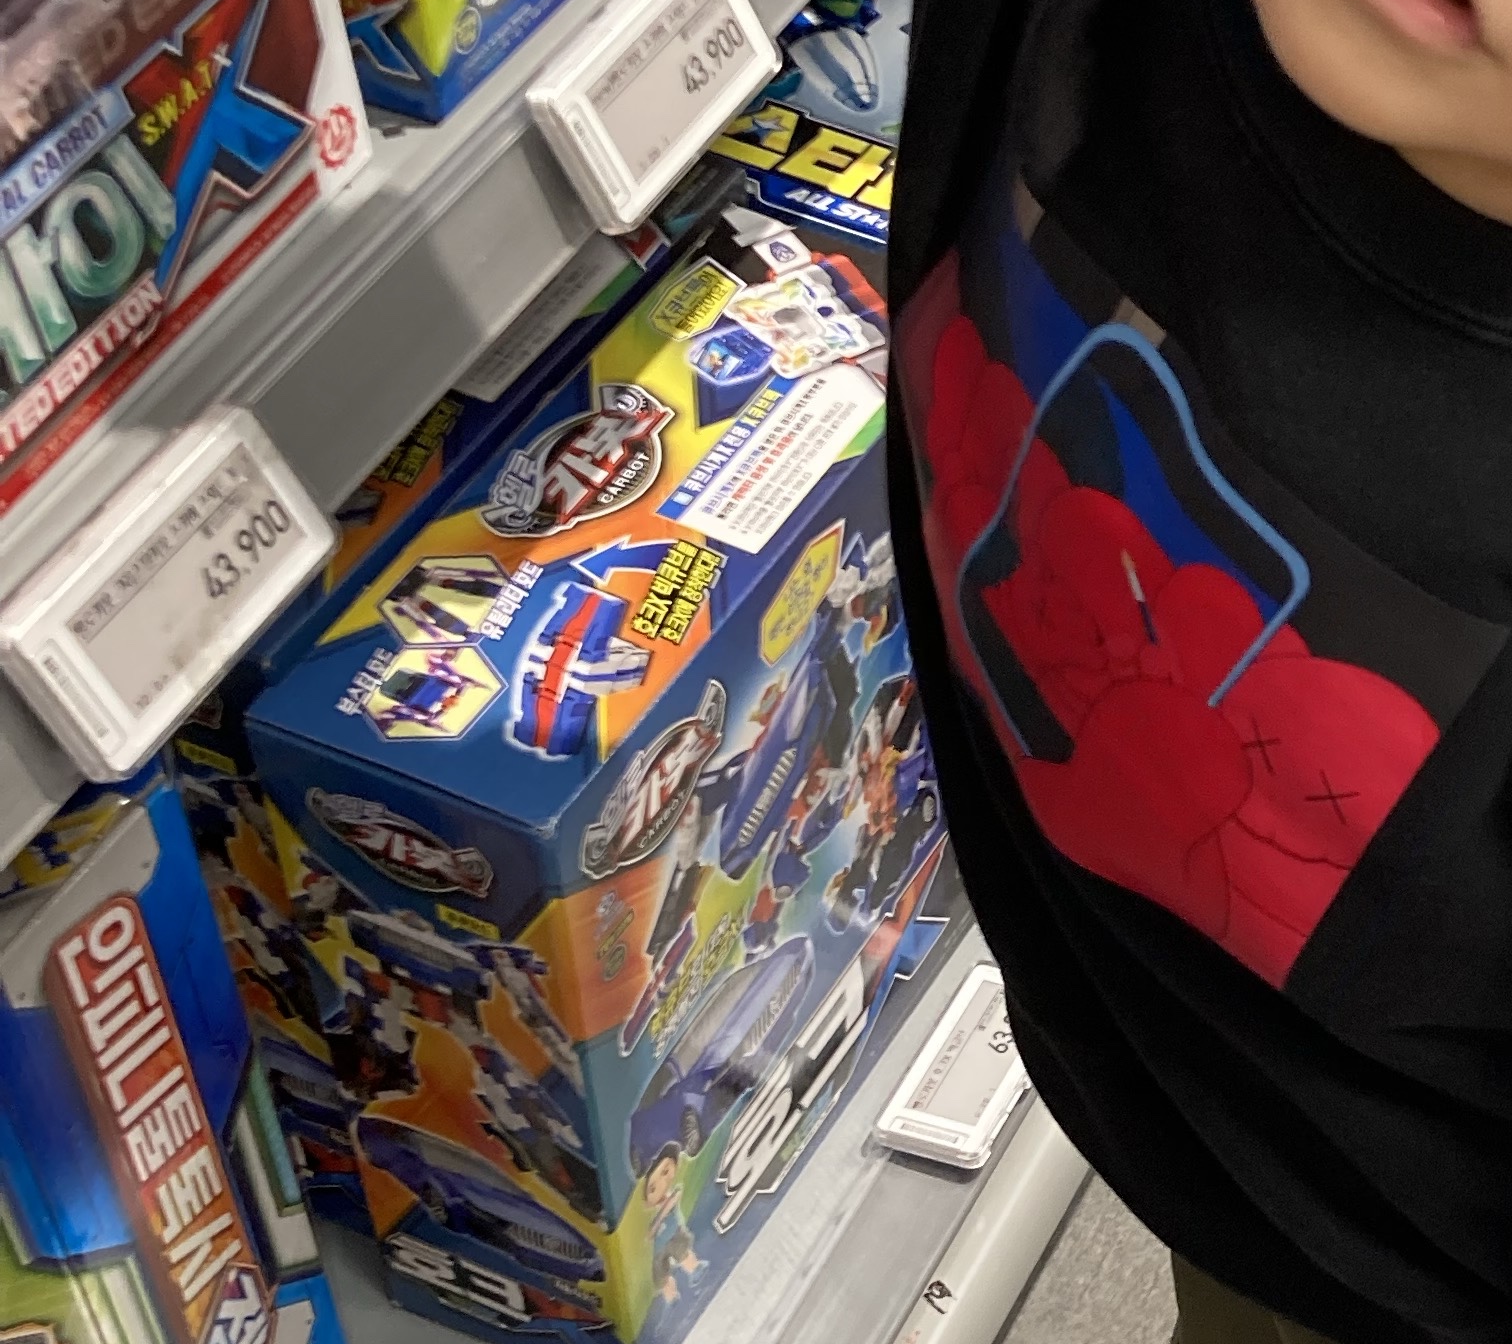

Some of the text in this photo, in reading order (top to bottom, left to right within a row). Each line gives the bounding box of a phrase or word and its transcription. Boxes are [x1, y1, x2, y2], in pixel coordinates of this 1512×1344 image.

[783, 185, 837, 213] ALL
[45, 276, 166, 404] EDITION
[546, 413, 657, 518] 카봇
[599, 451, 651, 506] CARBOT
[518, 559, 546, 591] 모드
[335, 646, 396, 717] 부스터 모드
